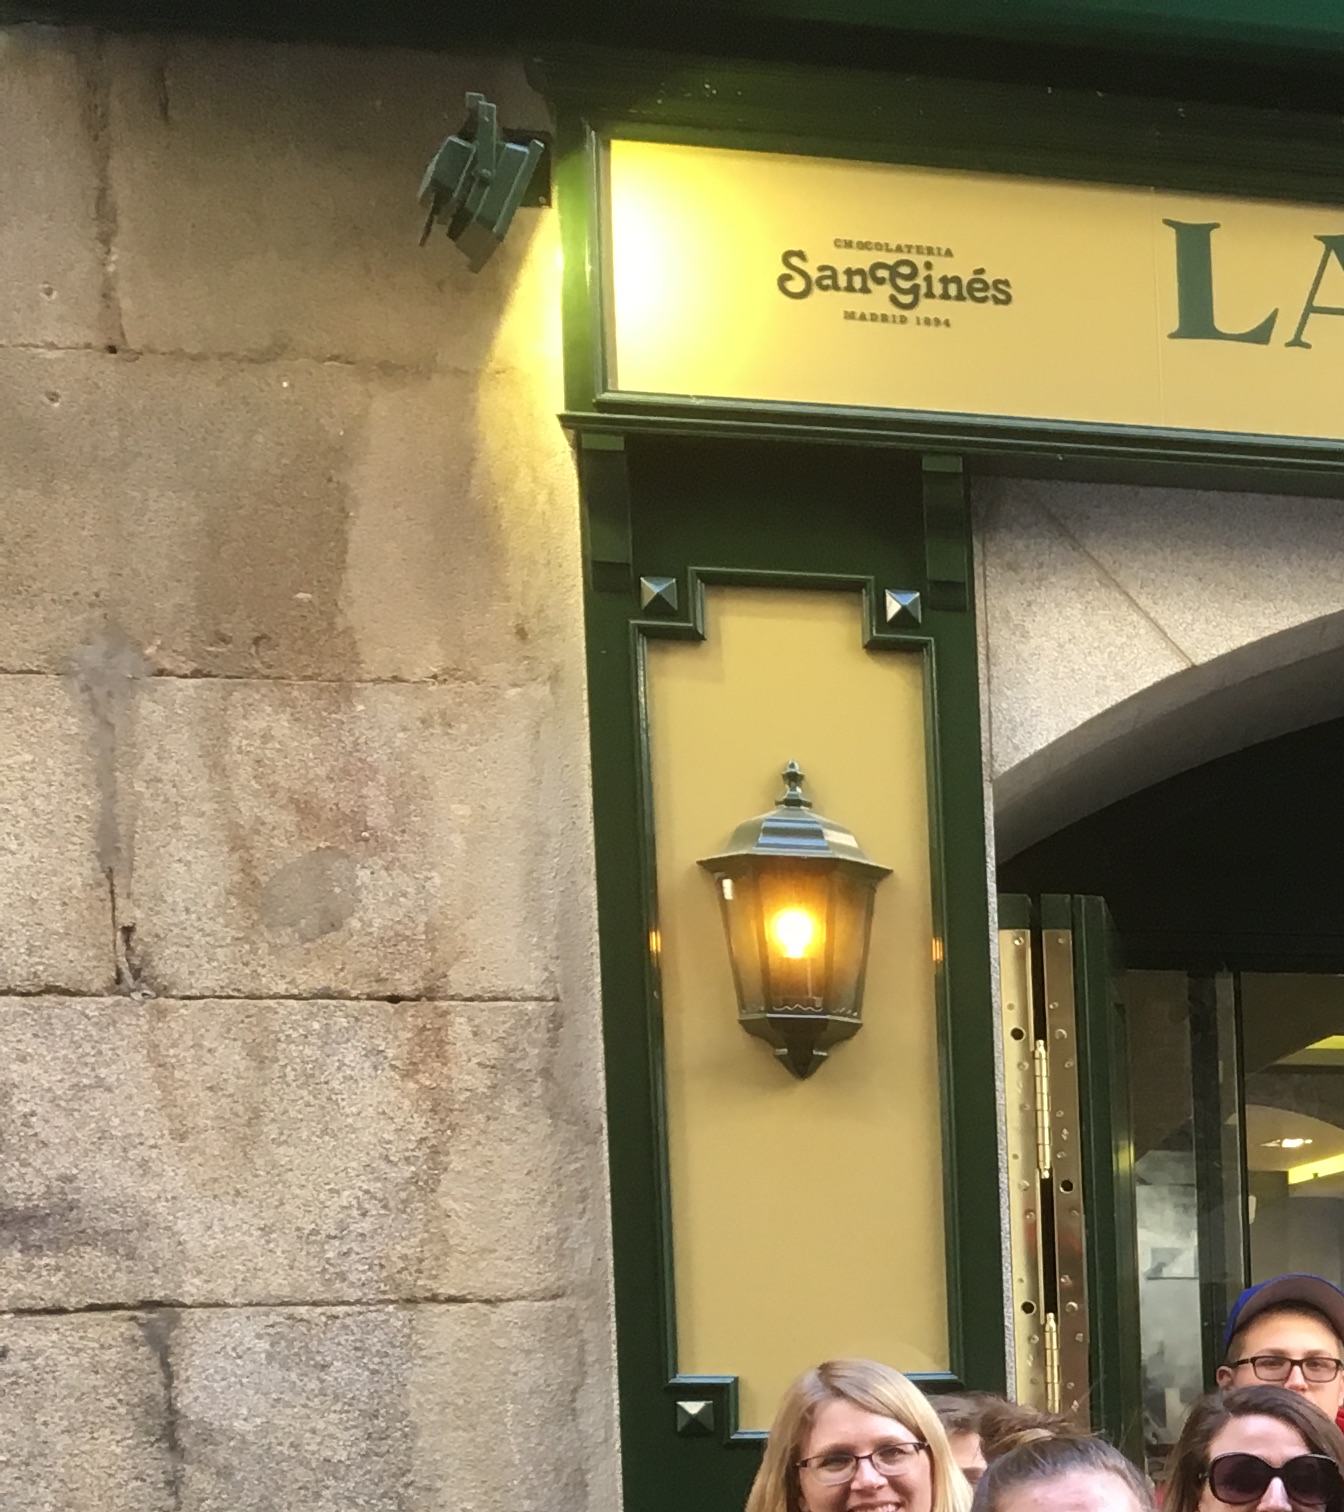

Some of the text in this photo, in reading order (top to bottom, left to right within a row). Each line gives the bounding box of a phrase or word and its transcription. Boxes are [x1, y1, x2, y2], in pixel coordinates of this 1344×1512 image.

[833, 238, 954, 258] CHOCOLATERIA
[843, 310, 952, 328] MADRID 1894
